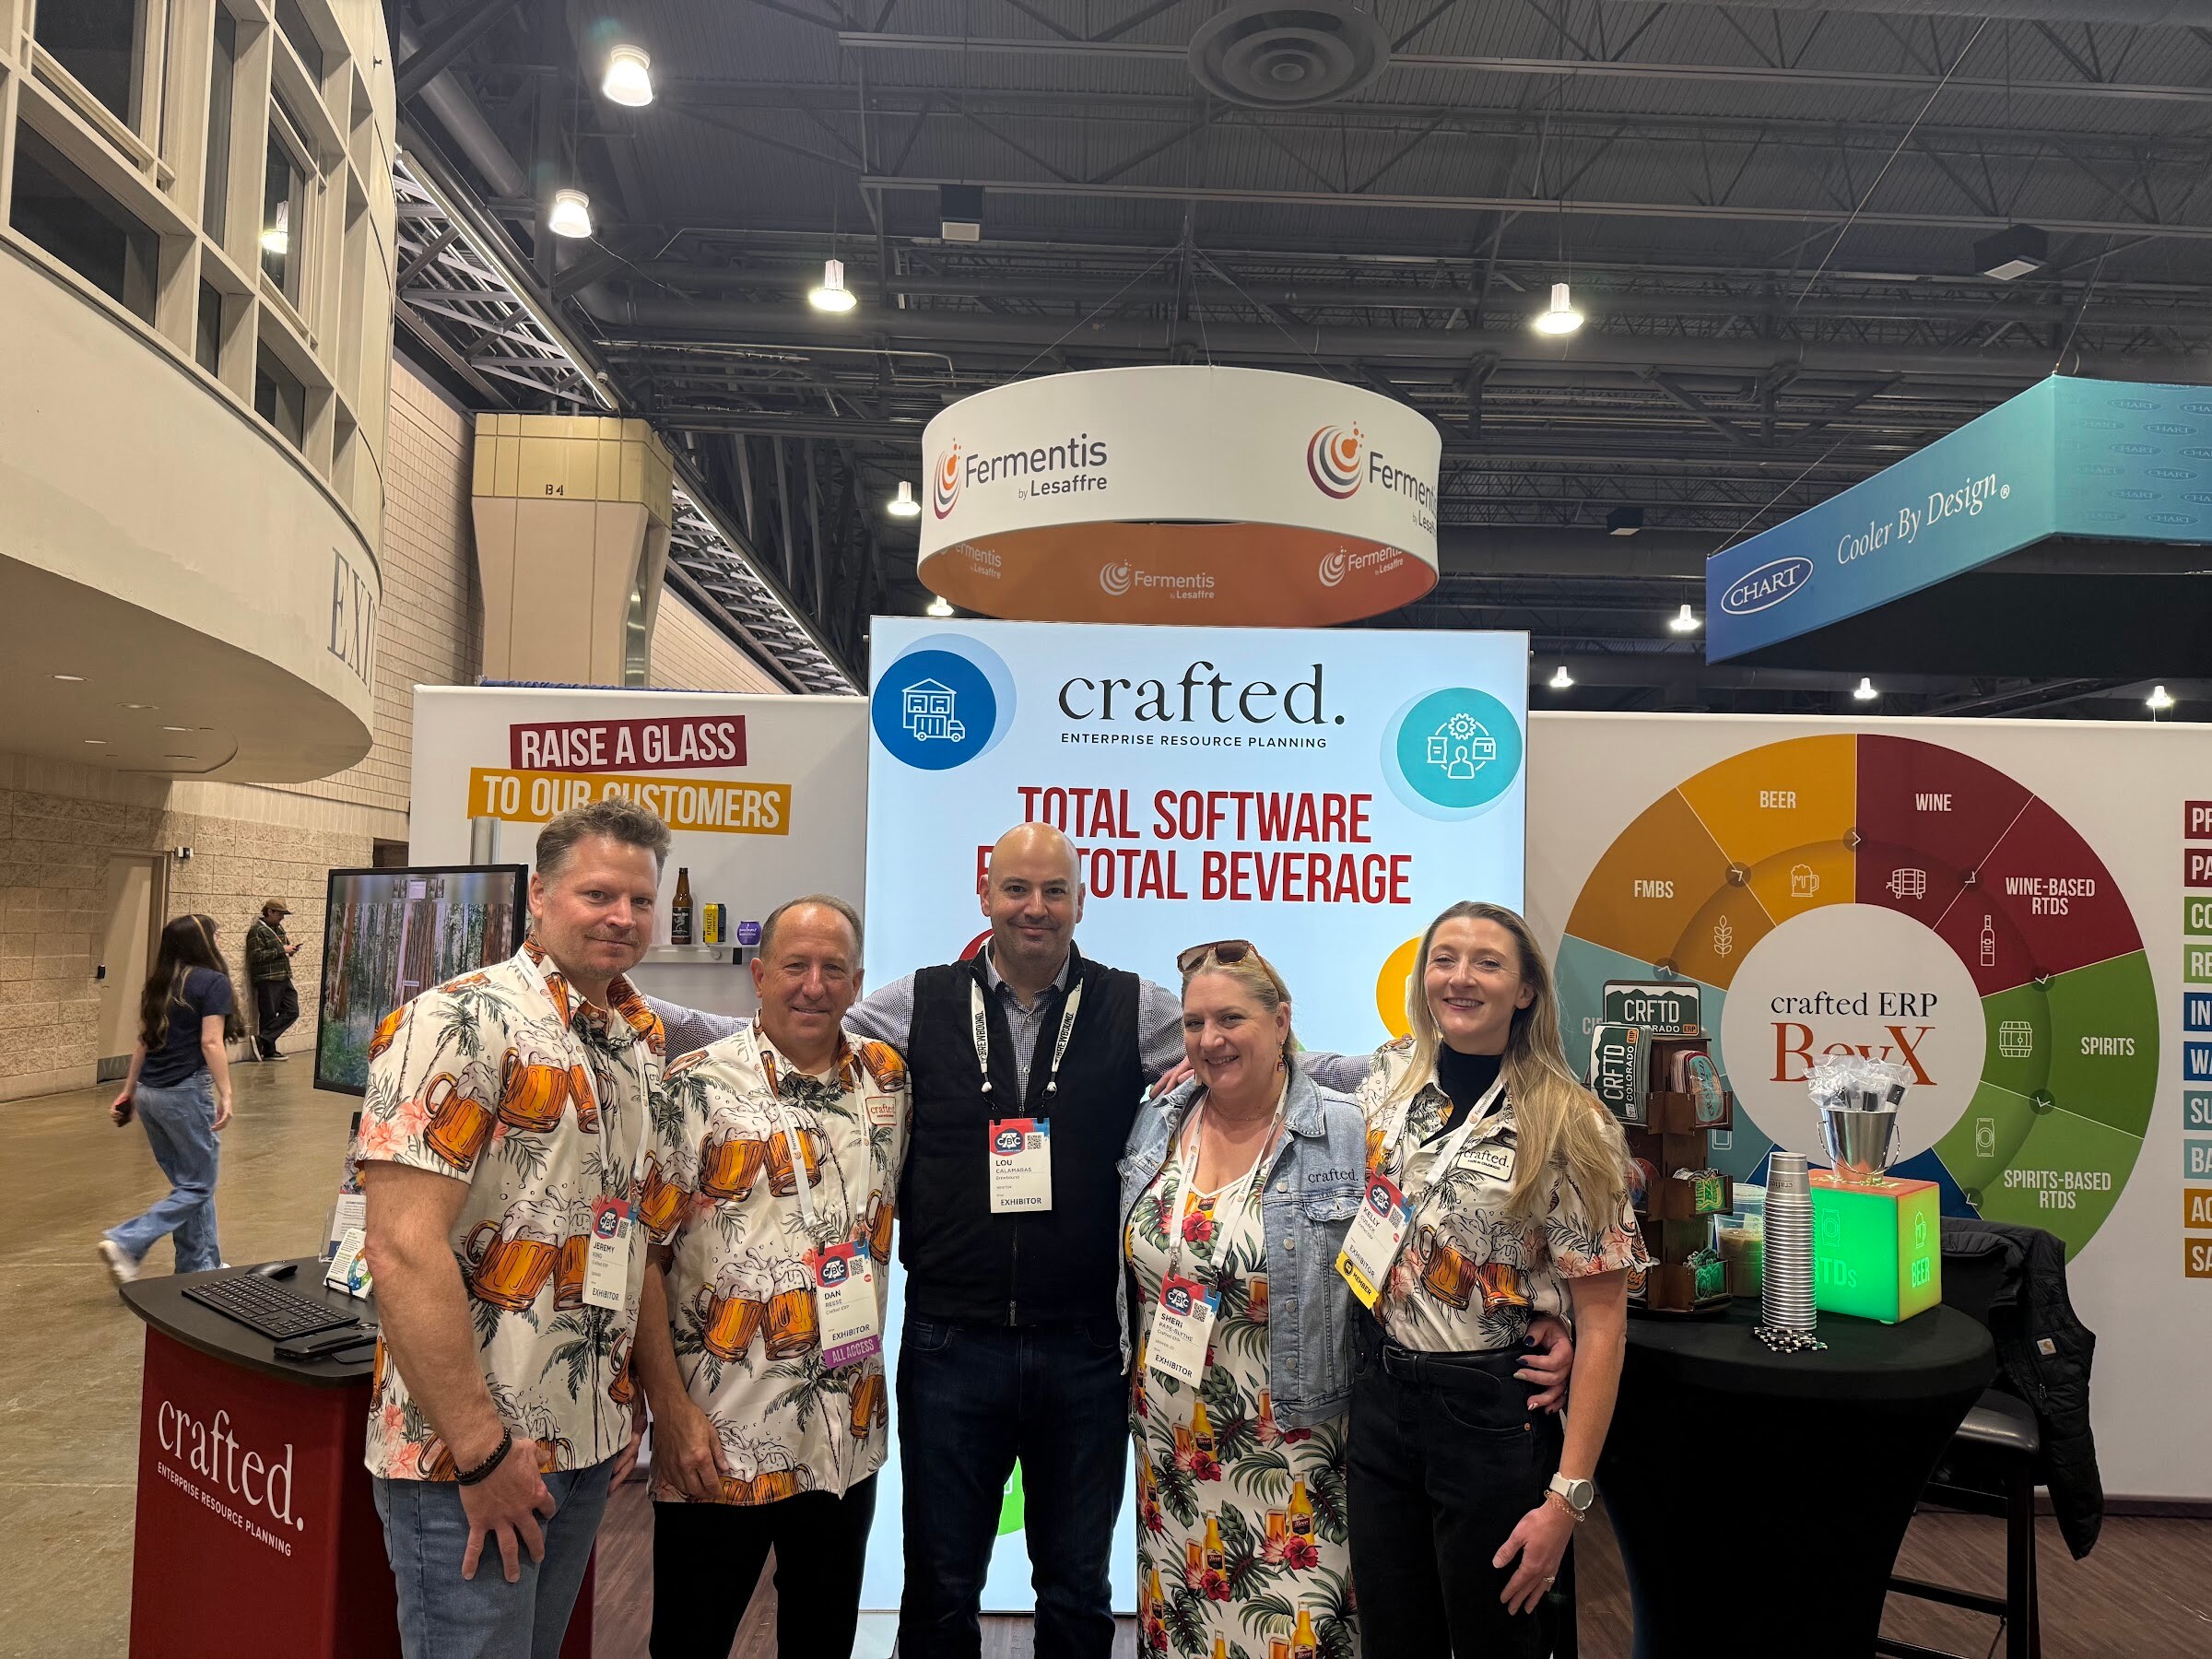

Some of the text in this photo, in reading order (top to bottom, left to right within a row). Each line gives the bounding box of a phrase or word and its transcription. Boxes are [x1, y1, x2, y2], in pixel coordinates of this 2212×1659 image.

[2147, 425, 2190, 434] CHART
[965, 432, 1108, 488] Fermentis
[2147, 469, 2190, 478] CHART
[1018, 475, 1108, 500] by Lesaffre
[2147, 513, 2190, 524] CHART
[1837, 521, 1893, 566] Cooler
[1897, 506, 1922, 544] By
[955, 543, 1002, 568] ermentis
[1379, 558, 1404, 573] Lesaffre
[1134, 571, 1215, 588] Fermentis
[1730, 564, 1801, 607] CHART
[1176, 590, 1215, 599] Lesaffre
[1058, 660, 1345, 725] crafted.
[521, 722, 736, 769] RAISE A GLASS
[1061, 733, 1328, 748] ENTERPRISE RESOURCE PLANNING
[482, 775, 522, 815] TO
[530, 778, 592, 817] OUR
[1759, 790, 1797, 809] BEER
[1914, 793, 1952, 812] WINE
[1018, 786, 1373, 843] TOTAL SOFTWARE
[1202, 851, 1412, 904] BEVERAGE
[2005, 877, 2097, 897] WINE-BASED
[1634, 879, 1675, 899] FMBS
[2031, 897, 2069, 916] RTDS
[1624, 999, 1680, 1023] CRFTD
[1771, 991, 1938, 1018] crafted ERP
[1770, 1022, 1938, 1086] BX
[2080, 1036, 2136, 1056] SPIRITS
[1603, 1044, 1625, 1100] CRFTD
[1626, 1045, 1635, 1102] COLORADO
[1308, 1168, 1359, 1183] crafted.
[2004, 1169, 2112, 1191] SPIRITS-BASED
[1000, 1197, 1042, 1206] EXHIBITOR
[2039, 1190, 2077, 1209] RTDS
[1363, 1206, 1381, 1228] KELLY
[593, 1241, 616, 1253] JEREMY
[1349, 1244, 1375, 1279] EXHIBITOR
[1912, 1256, 1931, 1288] BEER
[592, 1288, 619, 1301] EXHIBITOR
[824, 1289, 841, 1300] DAN
[1352, 1271, 1372, 1296] MEMBER
[1161, 1312, 1183, 1329] SHERI
[832, 1324, 871, 1342] EXHIBITOR
[832, 1339, 875, 1364] ALL ACCESS
[1155, 1354, 1194, 1379] EXHIBITOR
[158, 1400, 304, 1532] crafted.
[157, 1461, 291, 1558] ENTERPRISE RESOURCE PLANNING
